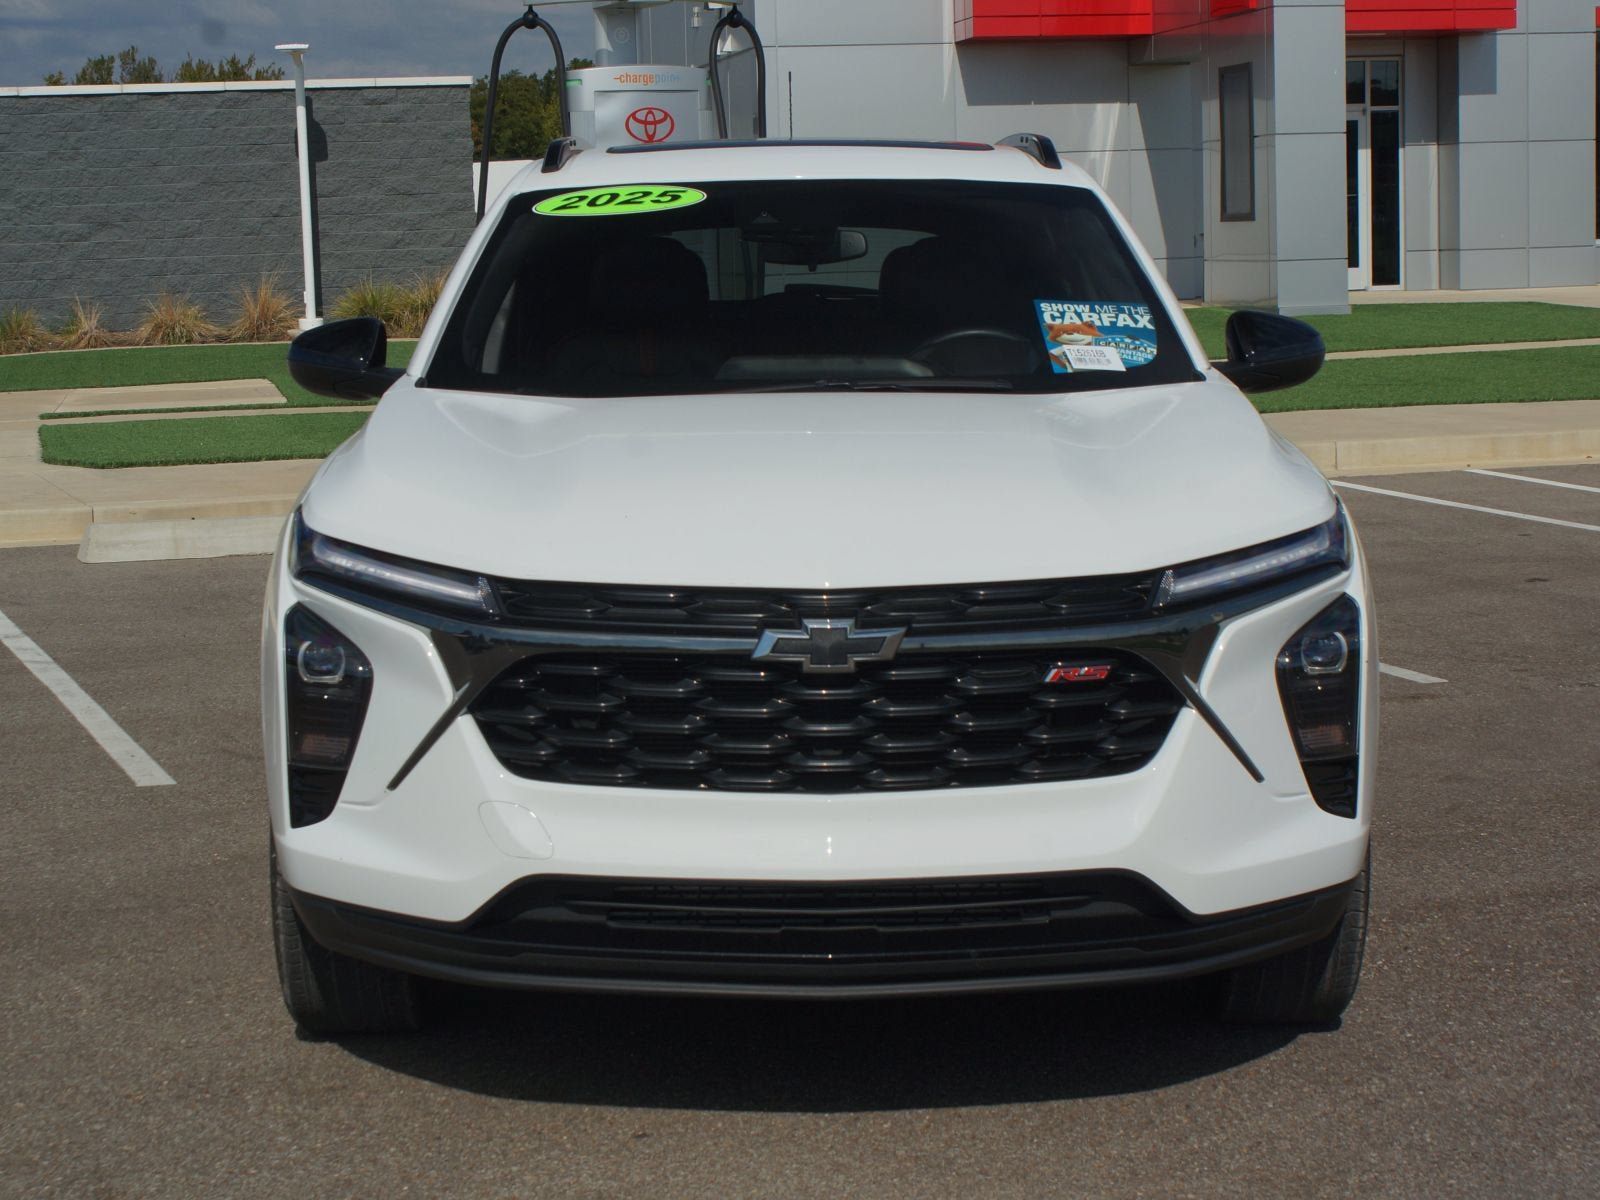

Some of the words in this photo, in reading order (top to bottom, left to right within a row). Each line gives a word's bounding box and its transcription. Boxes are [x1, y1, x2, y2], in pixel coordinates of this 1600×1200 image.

[549, 190, 688, 212] 2025
[1040, 302, 1090, 313] SHOW
[1094, 305, 1118, 314] ME
[1120, 305, 1153, 317] THE
[1043, 311, 1156, 330] CARFAX
[1045, 664, 1110, 682] RS
